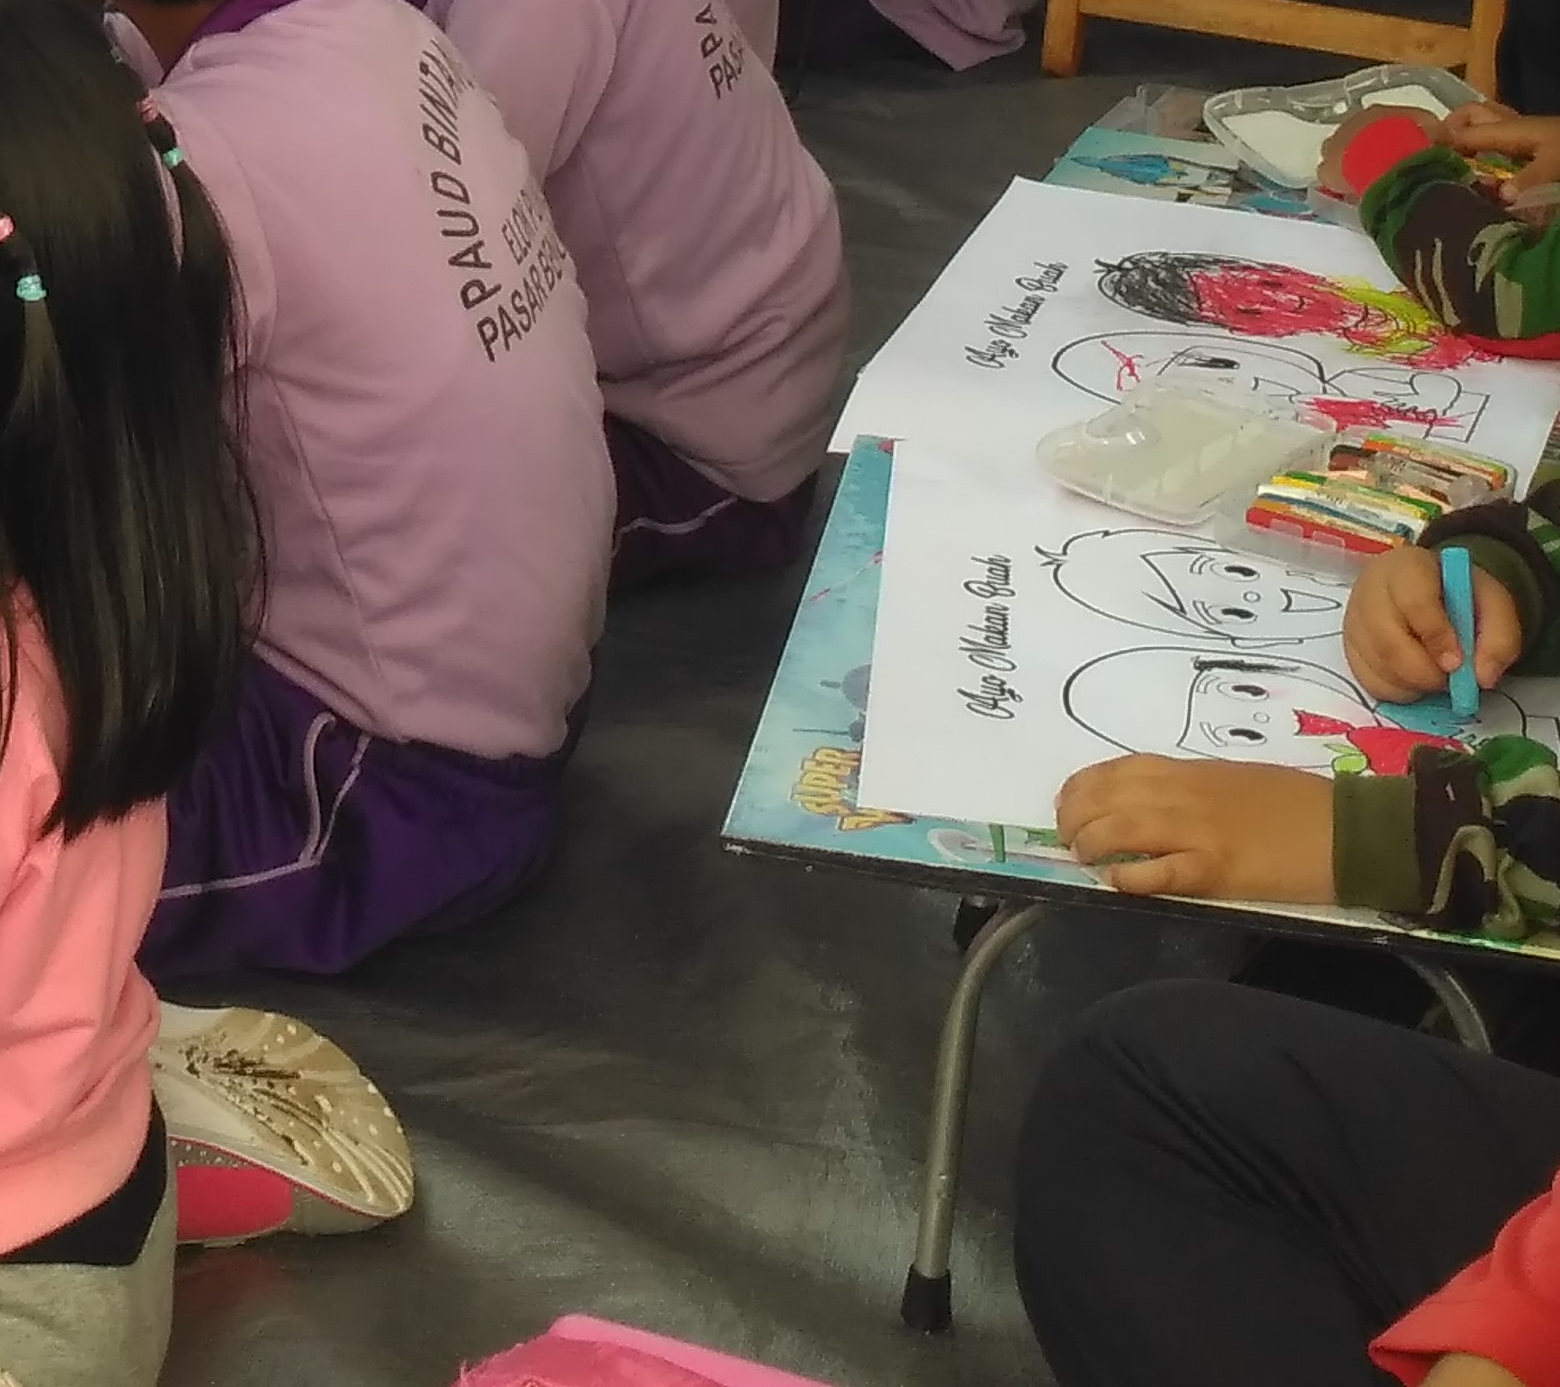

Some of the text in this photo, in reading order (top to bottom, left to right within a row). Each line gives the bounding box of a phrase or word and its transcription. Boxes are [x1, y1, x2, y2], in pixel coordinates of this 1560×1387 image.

[430, 170, 503, 311] PAUD
[964, 261, 1069, 369] Ayo Makan Buah
[956, 553, 1025, 720] Ayo Makan Buah
